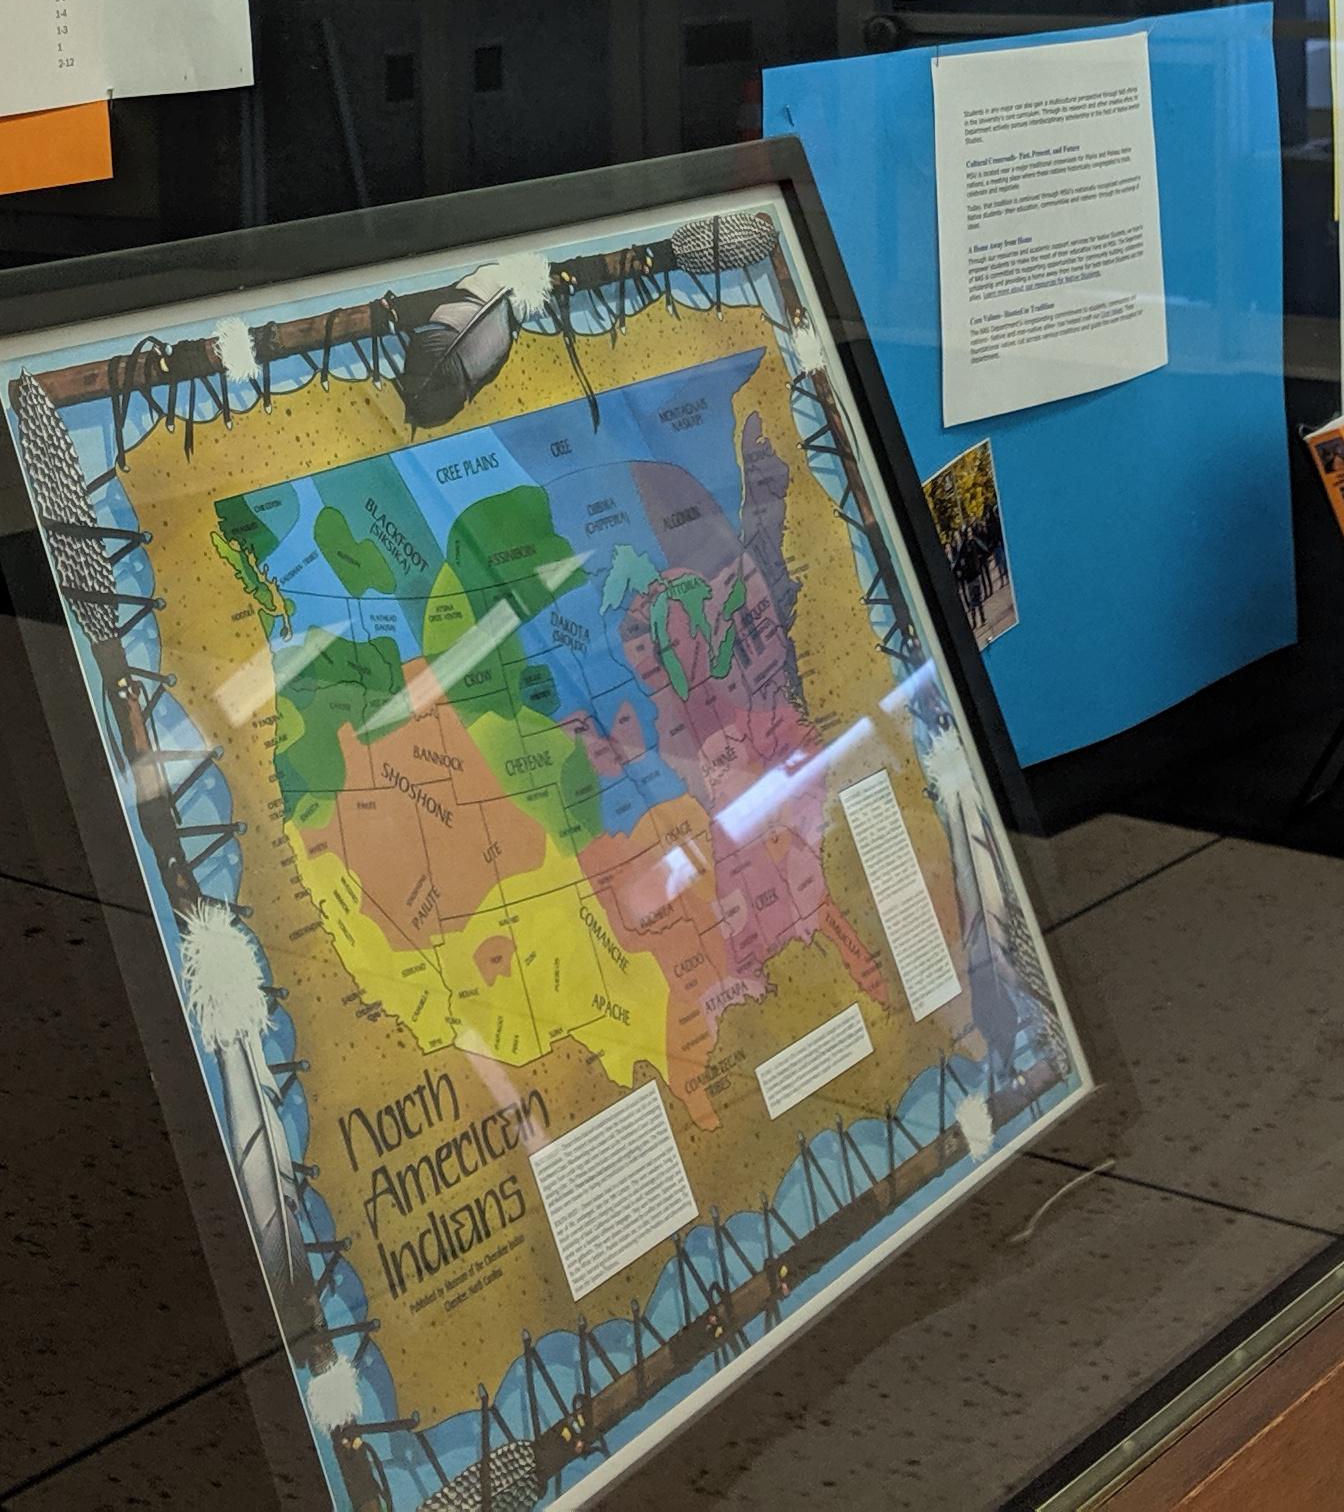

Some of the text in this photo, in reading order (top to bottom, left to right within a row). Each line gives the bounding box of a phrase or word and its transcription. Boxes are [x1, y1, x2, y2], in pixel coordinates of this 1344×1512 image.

[550, 439, 572, 457] CREE
[436, 453, 499, 485] CREE PLAINS
[364, 498, 429, 572] BLACKFOOT
[370, 522, 411, 575] (SIKSIKA)
[550, 612, 589, 640] DAKOTA
[464, 669, 492, 688] CROW
[413, 745, 464, 772] BANNOCK
[505, 750, 553, 777] CHEYENNE
[381, 762, 454, 829] SHOSHONE
[482, 844, 503, 864] UTE
[579, 906, 629, 973] COMANCHE
[592, 994, 631, 1026] APACHE
[338, 1069, 460, 1172] North
[364, 1089, 550, 1240] American
[377, 1175, 526, 1300] Indians
